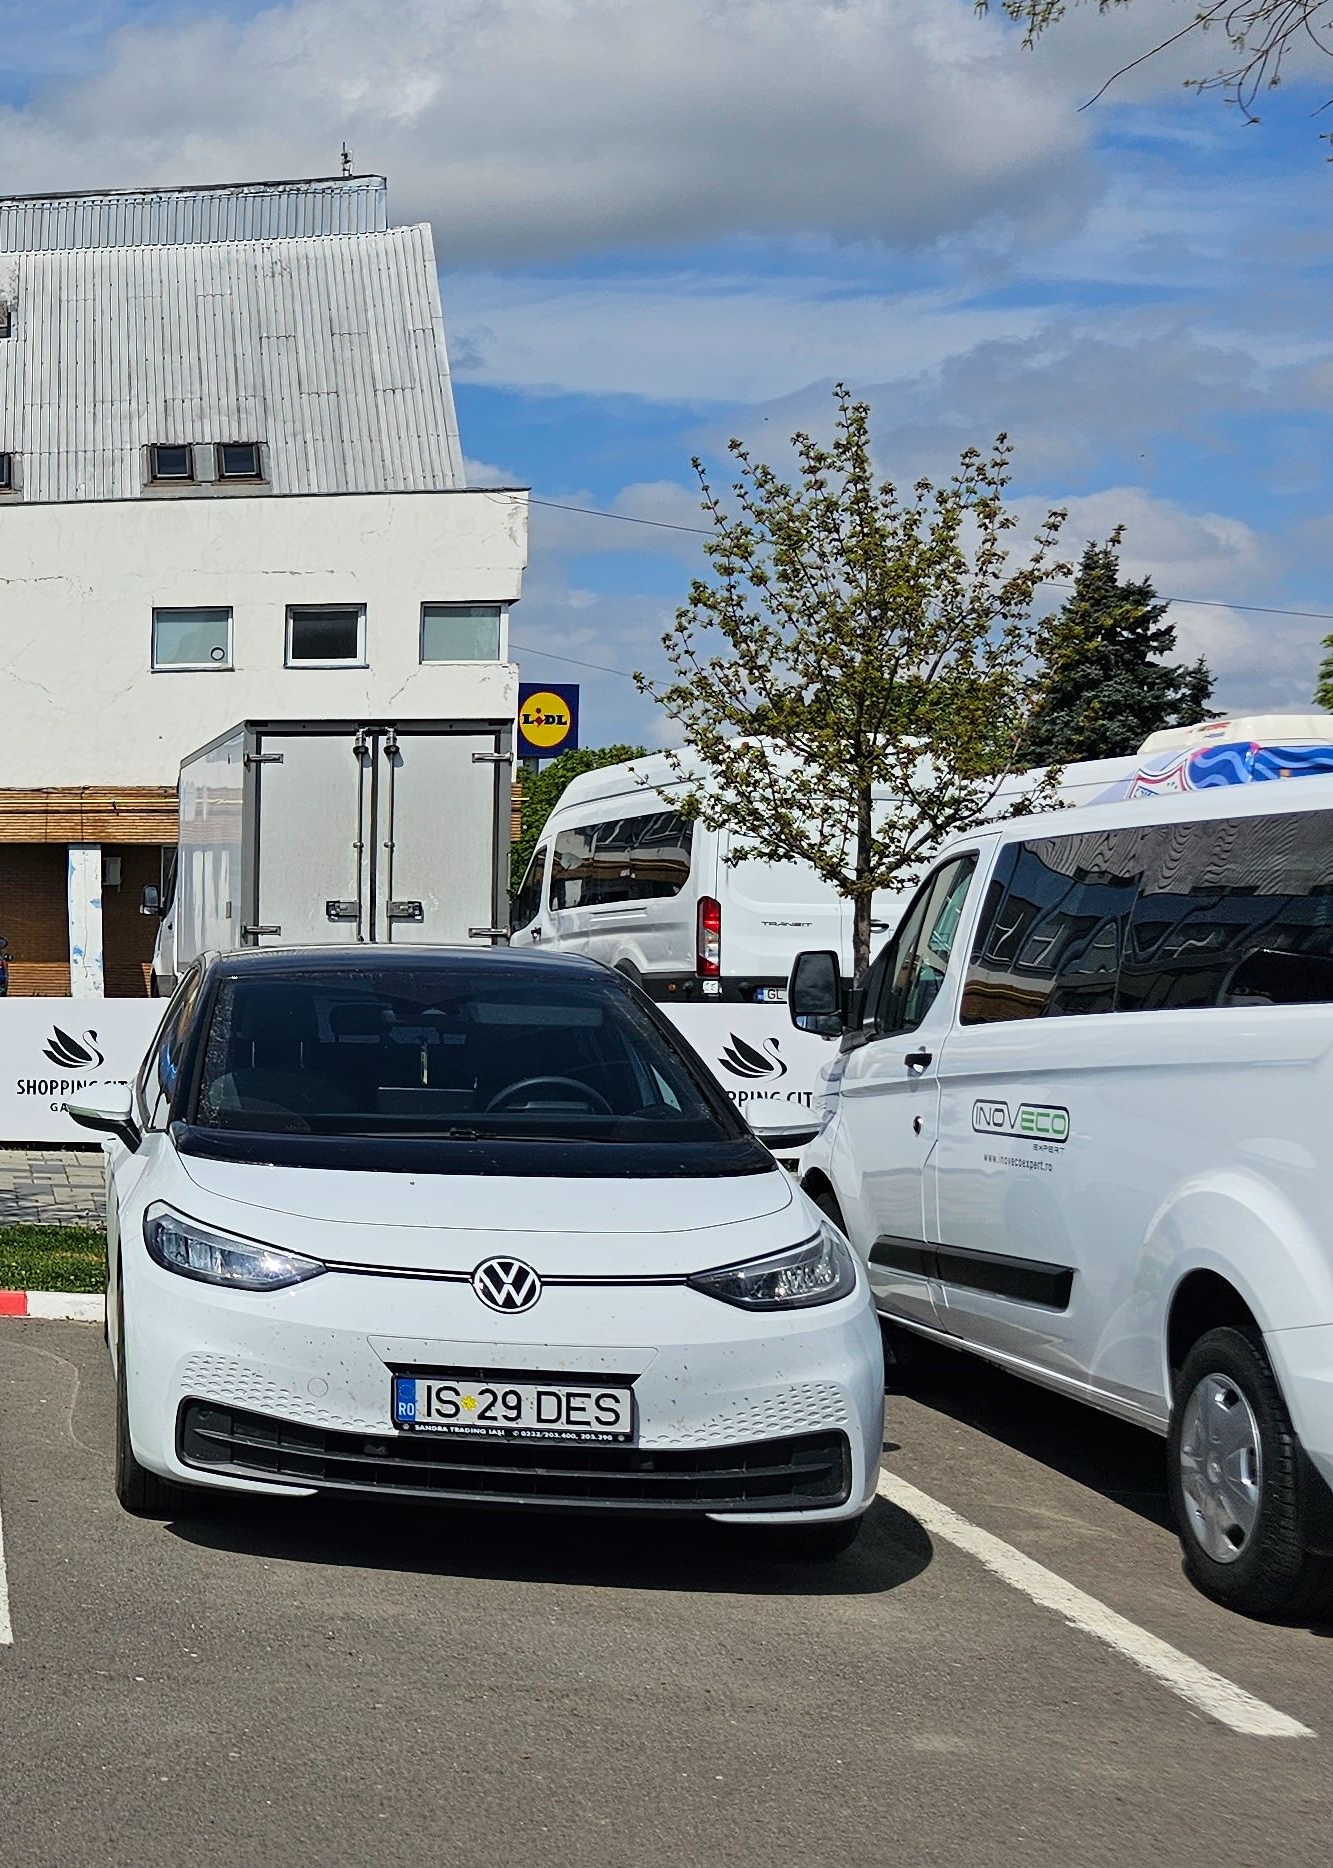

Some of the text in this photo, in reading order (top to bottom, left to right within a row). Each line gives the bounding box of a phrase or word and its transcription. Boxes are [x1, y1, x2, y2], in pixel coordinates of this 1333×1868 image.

[767, 988, 783, 1000] GL
[16, 1079, 97, 1095] SHOPPIN
[786, 1091, 813, 1108] CIT
[975, 1103, 1067, 1135] INOVECO
[1032, 1143, 1066, 1153] EXPERT
[983, 1154, 1052, 1172] www.inovecoexpert.ro
[398, 1384, 621, 1426] RO IS 29 DES
[414, 1424, 448, 1433] SANDRA
[450, 1426, 486, 1435] TRADING
